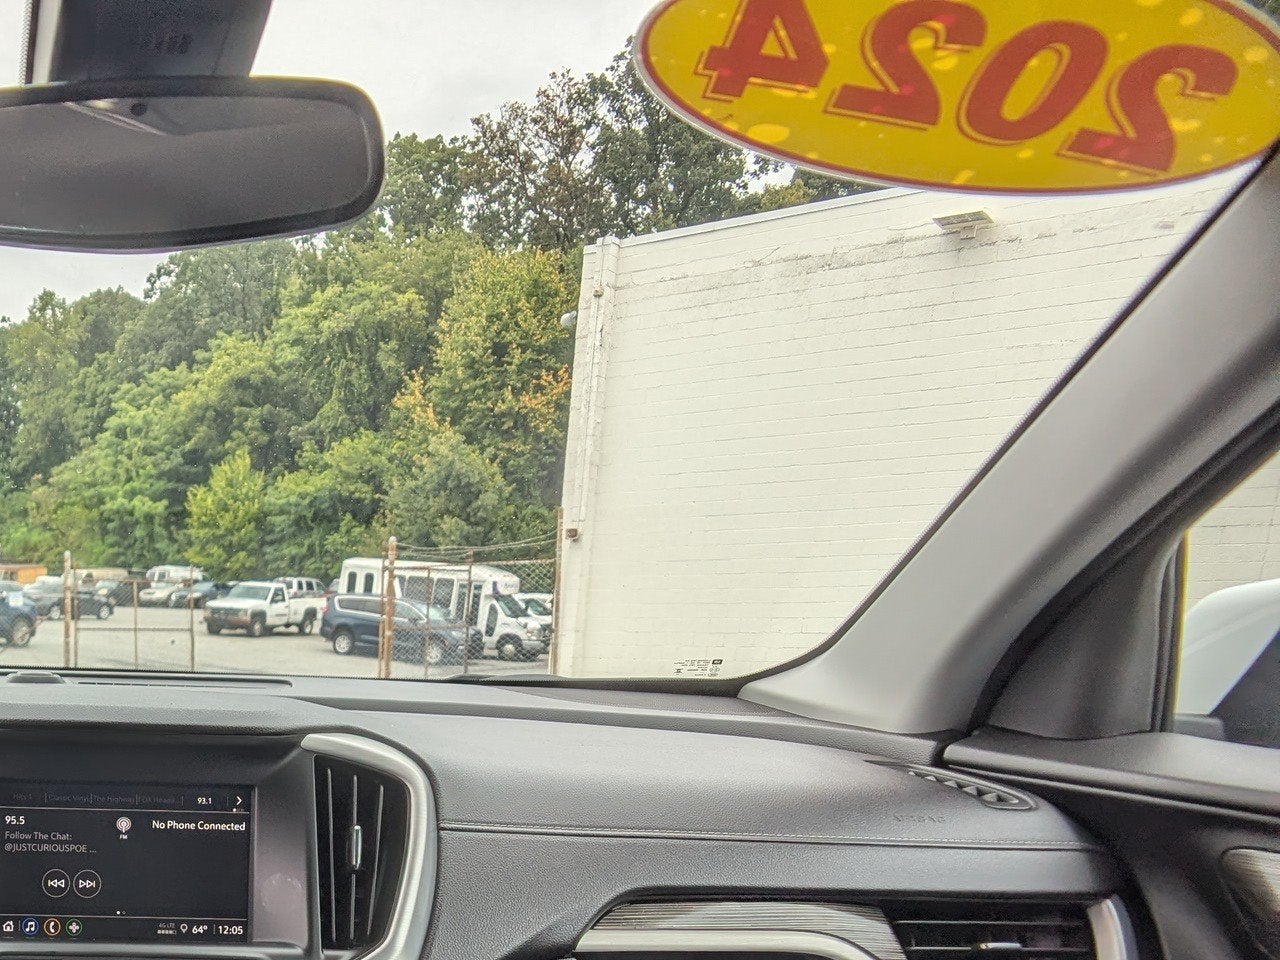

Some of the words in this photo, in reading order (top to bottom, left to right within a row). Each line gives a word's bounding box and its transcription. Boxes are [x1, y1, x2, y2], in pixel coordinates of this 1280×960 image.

[197, 796, 212, 805] 93.1
[4, 815, 26, 825] 95.5
[152, 820, 166, 830] No
[167, 819, 196, 830] Phone
[197, 820, 246, 831] Connected
[4, 830, 32, 840] Follow
[34, 831, 49, 840] The
[50, 831, 73, 841] Chat:
[4, 842, 88, 853] @JUSTCURIOUSPOE
[218, 925, 243, 935] 12:05
